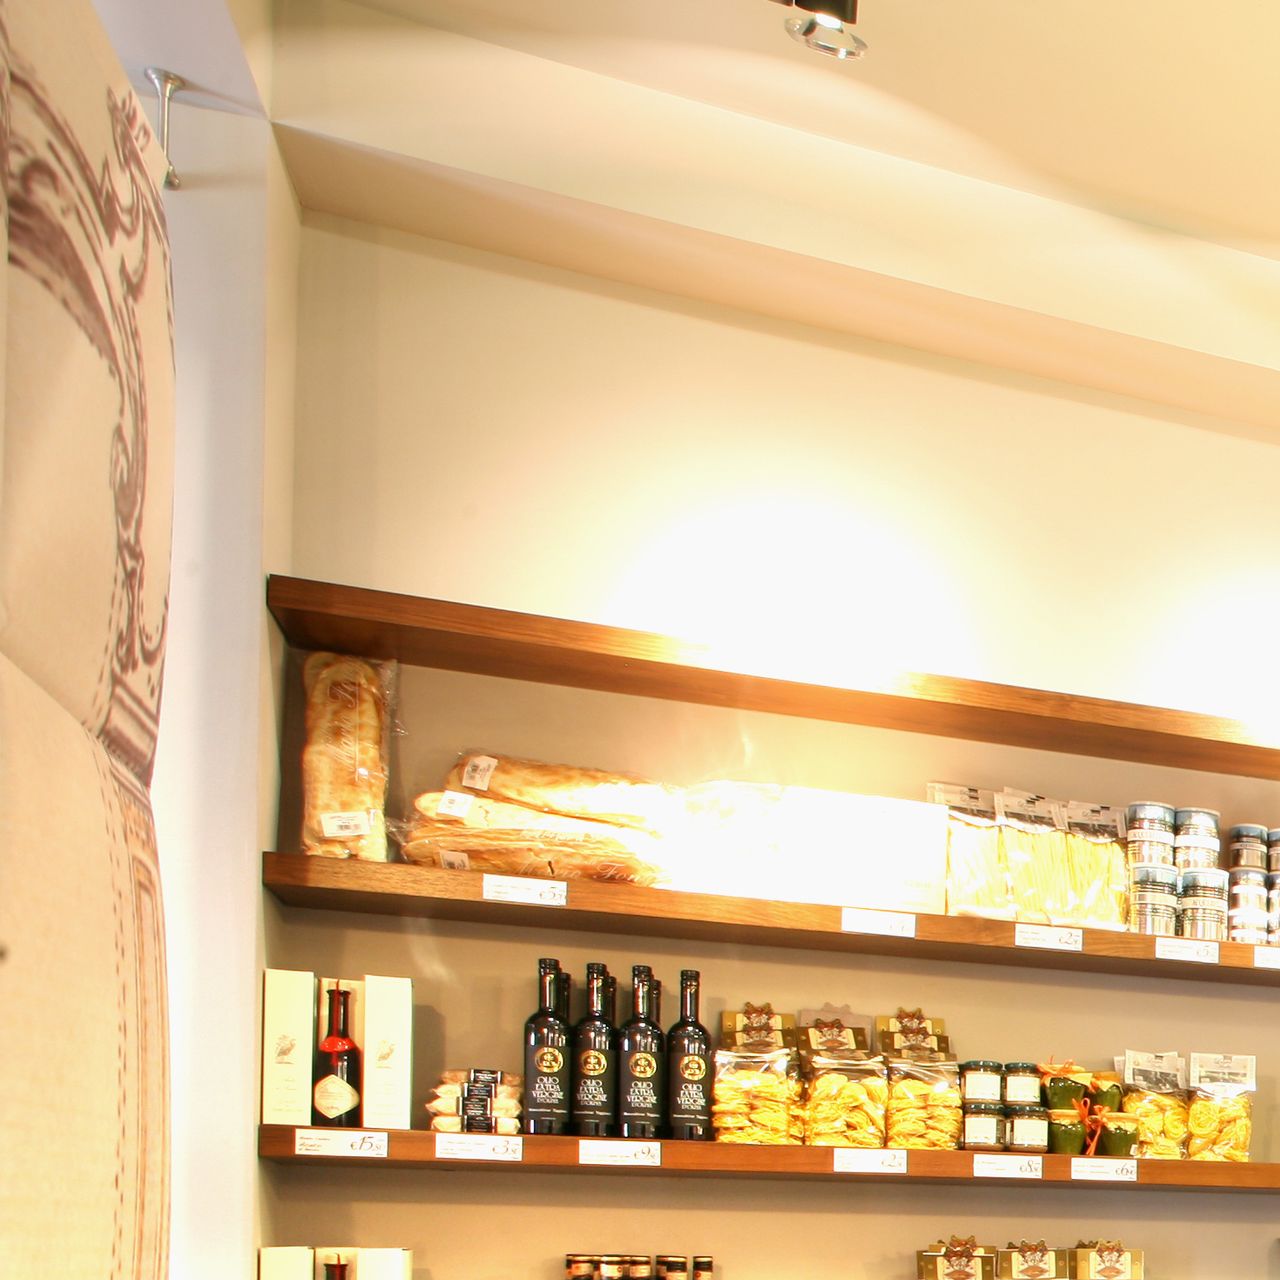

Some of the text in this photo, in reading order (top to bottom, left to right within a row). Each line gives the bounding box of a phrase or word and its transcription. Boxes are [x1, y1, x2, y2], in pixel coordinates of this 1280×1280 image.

[537, 1076, 560, 1085] OLIO
[581, 1079, 602, 1087] OLIO
[631, 1081, 653, 1089] OLIO
[535, 1083, 561, 1092] EXTRA
[579, 1086, 604, 1094] EXTRA
[630, 1088, 654, 1096] EXTRA
[682, 1083, 702, 1092] OLIO
[532, 1090, 564, 1100] VERGINE
[577, 1092, 607, 1102] VERGINE
[680, 1090, 704, 1099] EXTRA
[626, 1095, 657, 1104] VERGINE
[677, 1097, 706, 1106] VERGINE
